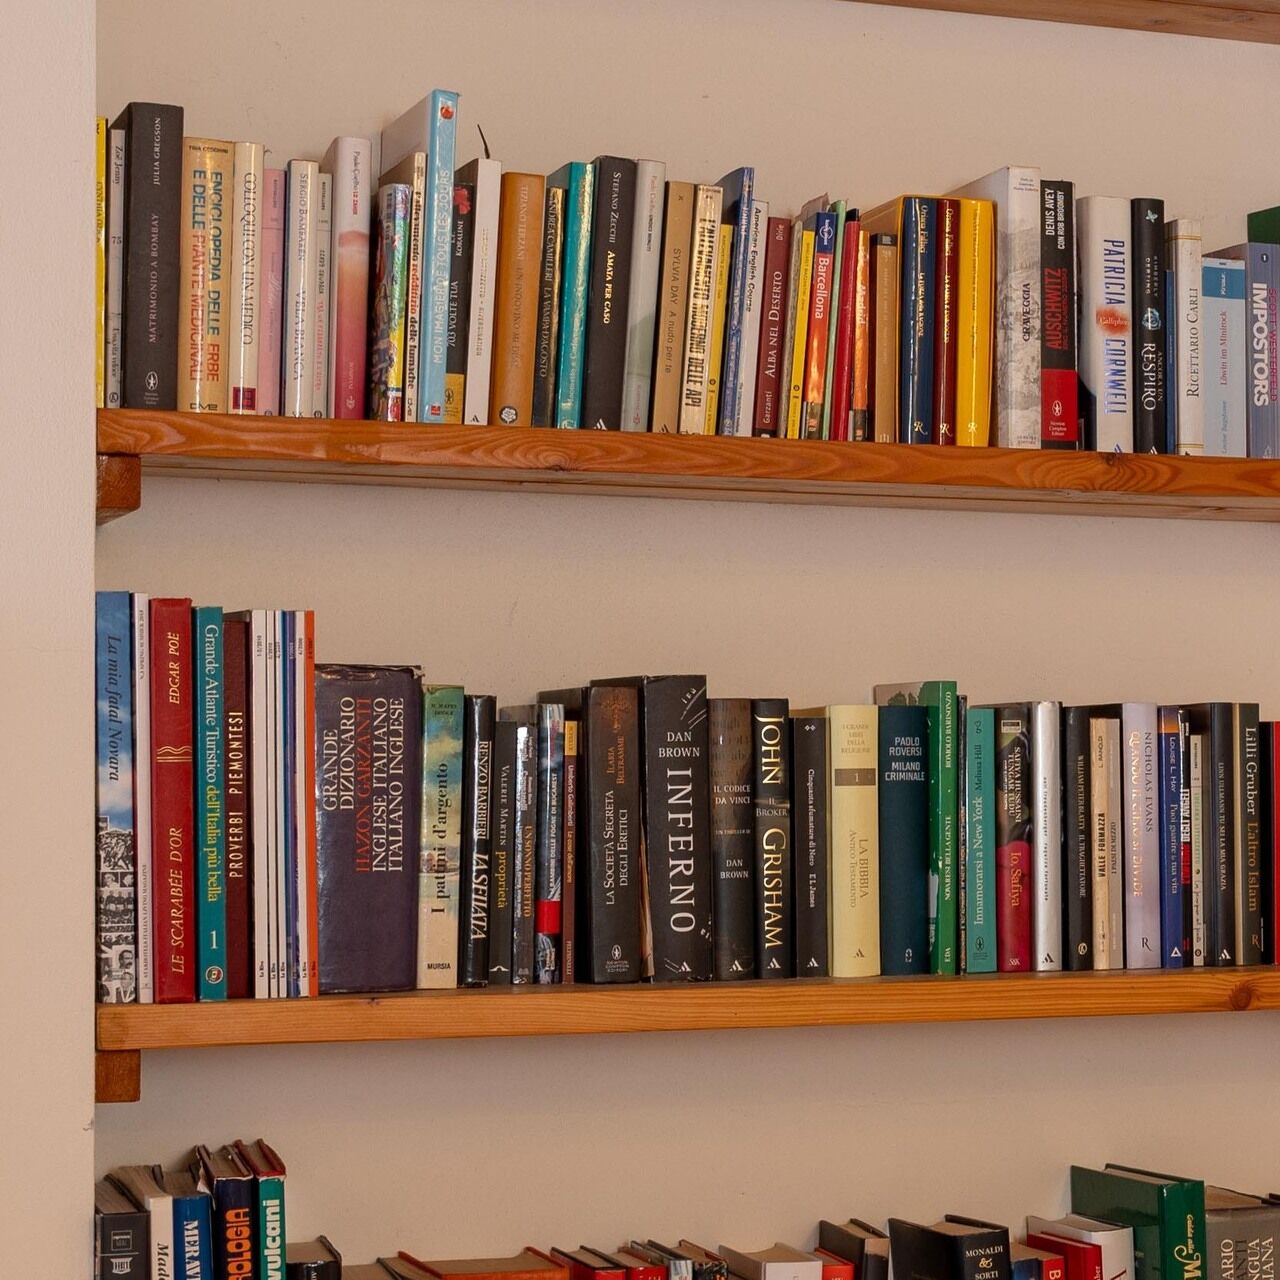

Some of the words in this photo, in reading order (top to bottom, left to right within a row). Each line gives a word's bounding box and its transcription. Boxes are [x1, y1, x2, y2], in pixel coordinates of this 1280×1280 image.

[193, 170, 206, 179] E
[610, 171, 622, 210] STEFANO
[192, 184, 206, 230] DELLE
[1045, 188, 1055, 213] AVEY
[112, 236, 122, 244] 75
[151, 214, 159, 257] BOMBAY
[456, 221, 464, 256] KORALINE
[608, 211, 620, 244] ZECCHI
[1045, 215, 1055, 236] DENIS
[192, 235, 206, 290] PIANTE
[606, 251, 616, 282] AMATA
[1104, 239, 1126, 306] PATRICIA
[149, 270, 158, 342] MATRIMONIO
[604, 284, 614, 299] PER
[768, 271, 783, 321] DESERTO
[815, 257, 829, 319] Barcellona
[1187, 288, 1199, 324] CARLI
[603, 300, 612, 324] CASO
[1022, 282, 1031, 342] CRAVEGGIA
[1045, 268, 1062, 350] AUSCHWITZ
[1269, 288, 1278, 328] SCOTT
[190, 294, 205, 382] MEDICINALI
[768, 326, 779, 344] NEL
[1252, 282, 1269, 407] IMPOSTORS
[765, 346, 777, 378] ALBA
[1104, 339, 1127, 416] CORNWELL
[1141, 343, 1157, 411] RESPIRO
[1186, 327, 1200, 398] RICETTARIO
[1269, 330, 1278, 402] WESTERFELD
[205, 624, 219, 675] Grande
[205, 677, 220, 726] Atlante
[206, 727, 221, 783] Turistico
[229, 711, 244, 795] PIEMONTESI
[340, 697, 355, 810] DIZIONARIO
[372, 697, 388, 788] ITALIANO
[389, 698, 404, 774] INGLESE
[658, 747, 701, 758] BROWN
[666, 731, 692, 743] DAN
[754, 714, 785, 785] JOHN
[888, 746, 922, 757] ROVERSI
[894, 737, 920, 746] PAOLO
[1245, 728, 1257, 759] Lilli
[323, 729, 338, 811] GRANDE
[607, 746, 615, 774] ILARIA
[854, 772, 859, 783] 1
[885, 771, 925, 781] CRIMINALE
[891, 761, 921, 771] MILANO
[1014, 746, 1022, 778] SAFIYA
[1145, 732, 1153, 792] NICHOLAS
[500, 765, 510, 805] VALERIE
[713, 785, 723, 793] IL
[723, 784, 751, 793] CODICE
[715, 797, 727, 805] DA
[729, 796, 751, 805] VINCI
[1014, 780, 1022, 823] HUSSAINI
[1245, 761, 1258, 816] Gruber
[206, 785, 221, 846] dell'Italia
[755, 808, 788, 817] BROKER
[972, 796, 984, 817] York
[1145, 796, 1153, 833] EVANS
[229, 812, 244, 879] PROVERBI
[372, 795, 387, 872] INGLESE
[389, 781, 404, 872] ITALIANO
[499, 808, 509, 846] MARTIN
[617, 809, 629, 851] ERETICI
[974, 823, 984, 849] New
[1098, 813, 1106, 852] FORMAZZA
[1247, 822, 1259, 867] L'altro
[204, 846, 221, 869] più
[666, 768, 696, 933] INFERNO
[726, 858, 743, 867] DAN
[859, 838, 869, 855] LA
[207, 871, 222, 902] bella
[496, 850, 508, 909] proprietà
[619, 851, 629, 887] DEGLI
[720, 870, 749, 879] BROWN
[859, 858, 869, 898] BIBBIA
[1097, 856, 1106, 878] VALLE
[762, 828, 787, 950] GRISHAM
[974, 858, 984, 926] Innamorarsi
[1248, 871, 1260, 912] Islam
[427, 963, 451, 971] MURSIA
[965, 1245, 1004, 1258] MONALDI
[978, 1257, 993, 1269] &
[974, 1271, 999, 1280] SORTI
